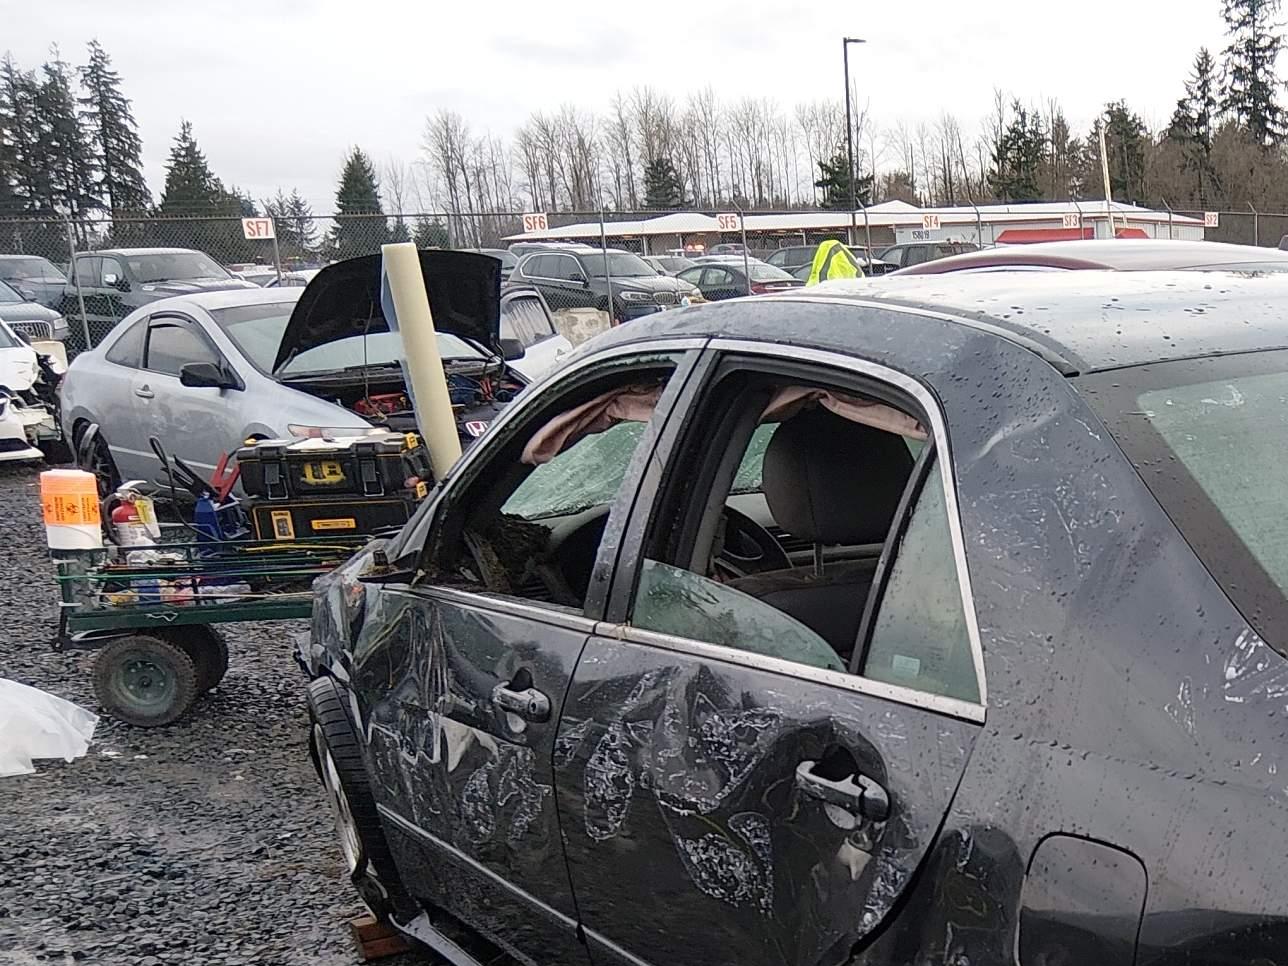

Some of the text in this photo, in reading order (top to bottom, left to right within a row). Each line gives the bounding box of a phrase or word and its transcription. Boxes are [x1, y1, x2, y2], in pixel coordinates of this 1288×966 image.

[525, 215, 546, 231] SF6
[718, 215, 737, 230] SF5
[924, 215, 939, 228] SF4
[1064, 215, 1078, 227] SF3
[1205, 214, 1218, 226] SF2
[246, 220, 269, 237] SF7
